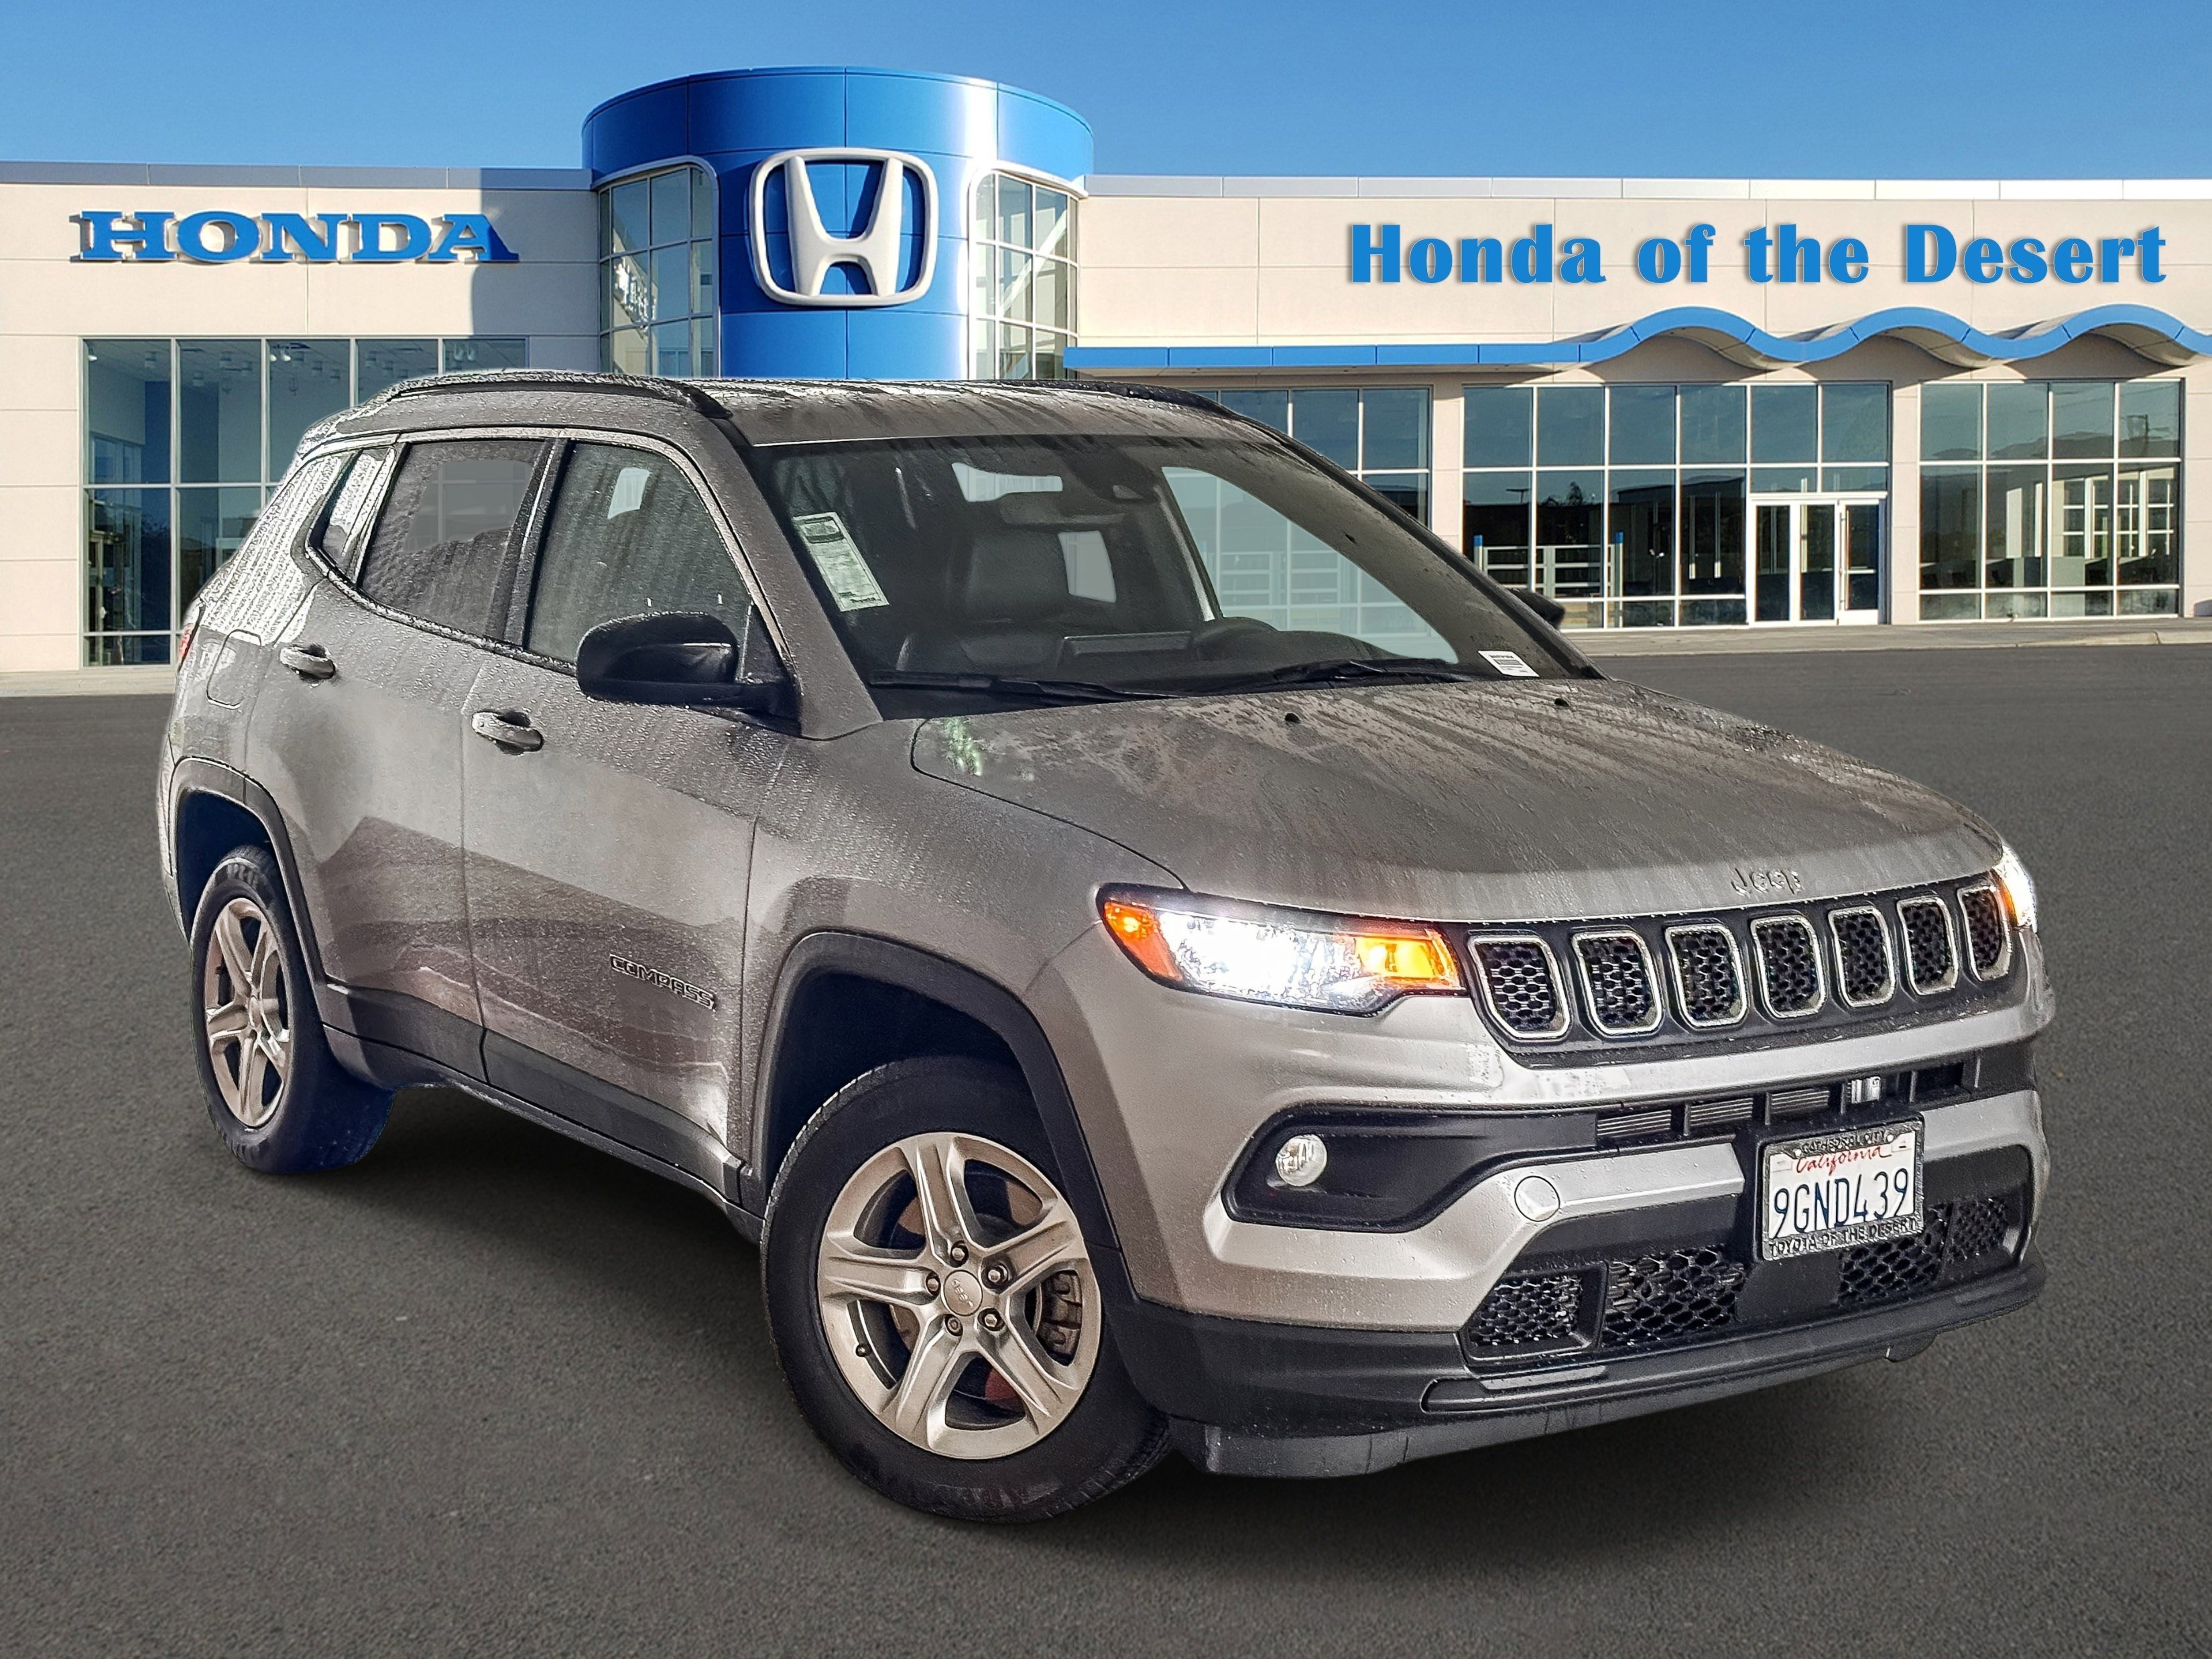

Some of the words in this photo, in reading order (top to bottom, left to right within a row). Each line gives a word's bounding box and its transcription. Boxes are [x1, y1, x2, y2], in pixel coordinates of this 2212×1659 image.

[79, 210, 520, 262] HONDA
[1351, 223, 1607, 284] Honda
[1637, 223, 1717, 284] of
[1743, 223, 1869, 284] the
[1904, 224, 2167, 284] Desert
[1730, 867, 1804, 899] Jeep
[609, 953, 717, 1010] COMPASS
[1796, 1146, 1893, 1176] California
[1774, 1168, 1908, 1240] 9GND439
[1768, 1237, 1819, 1257] TOYOTA
[1843, 1224, 1868, 1243] THE
